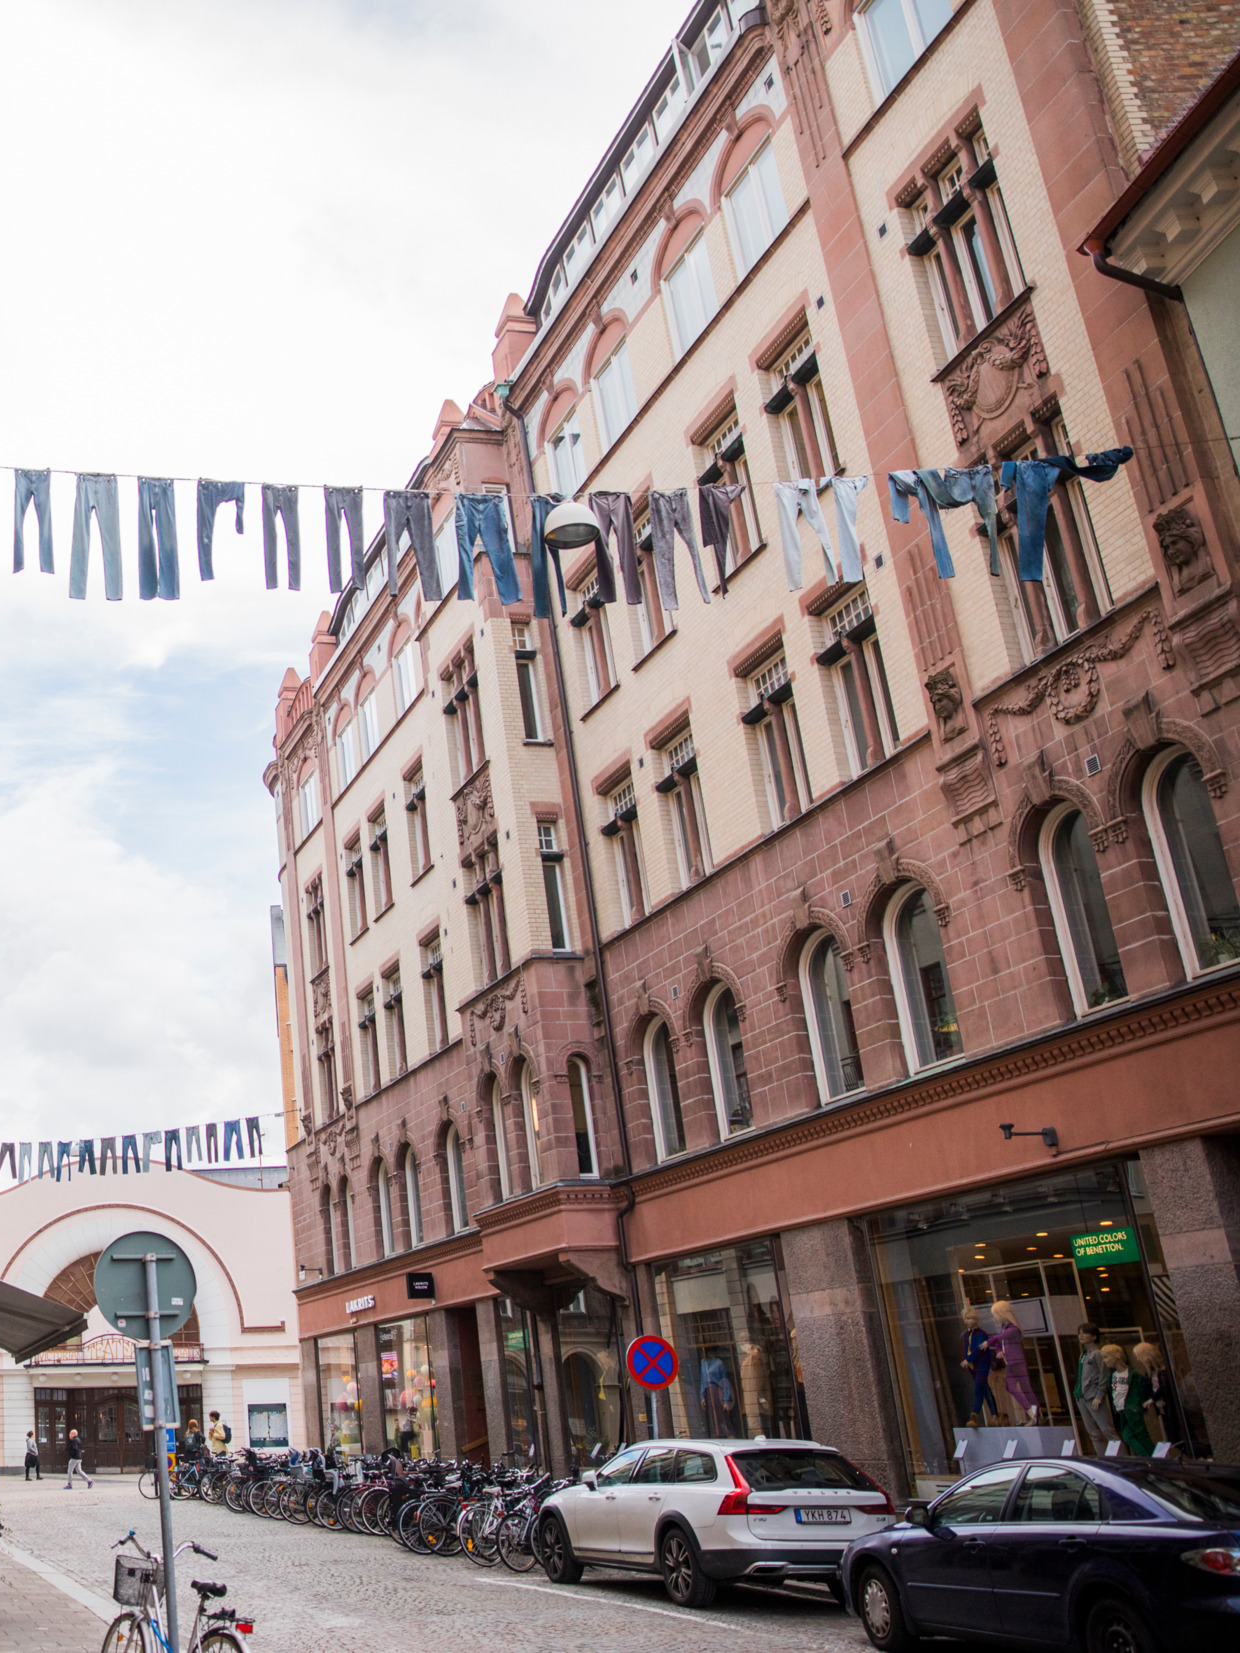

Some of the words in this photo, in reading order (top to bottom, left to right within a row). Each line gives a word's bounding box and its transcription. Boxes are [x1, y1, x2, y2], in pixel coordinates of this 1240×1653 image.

[1073, 1235, 1099, 1247] UNITED
[1099, 1231, 1127, 1243] COLORS
[1075, 1247, 1086, 1256] OF
[1085, 1242, 1124, 1255] BENETTON.
[345, 1295, 375, 1314] LAKRITS
[804, 1510, 824, 1521] YKH
[827, 1510, 847, 1520] 874
